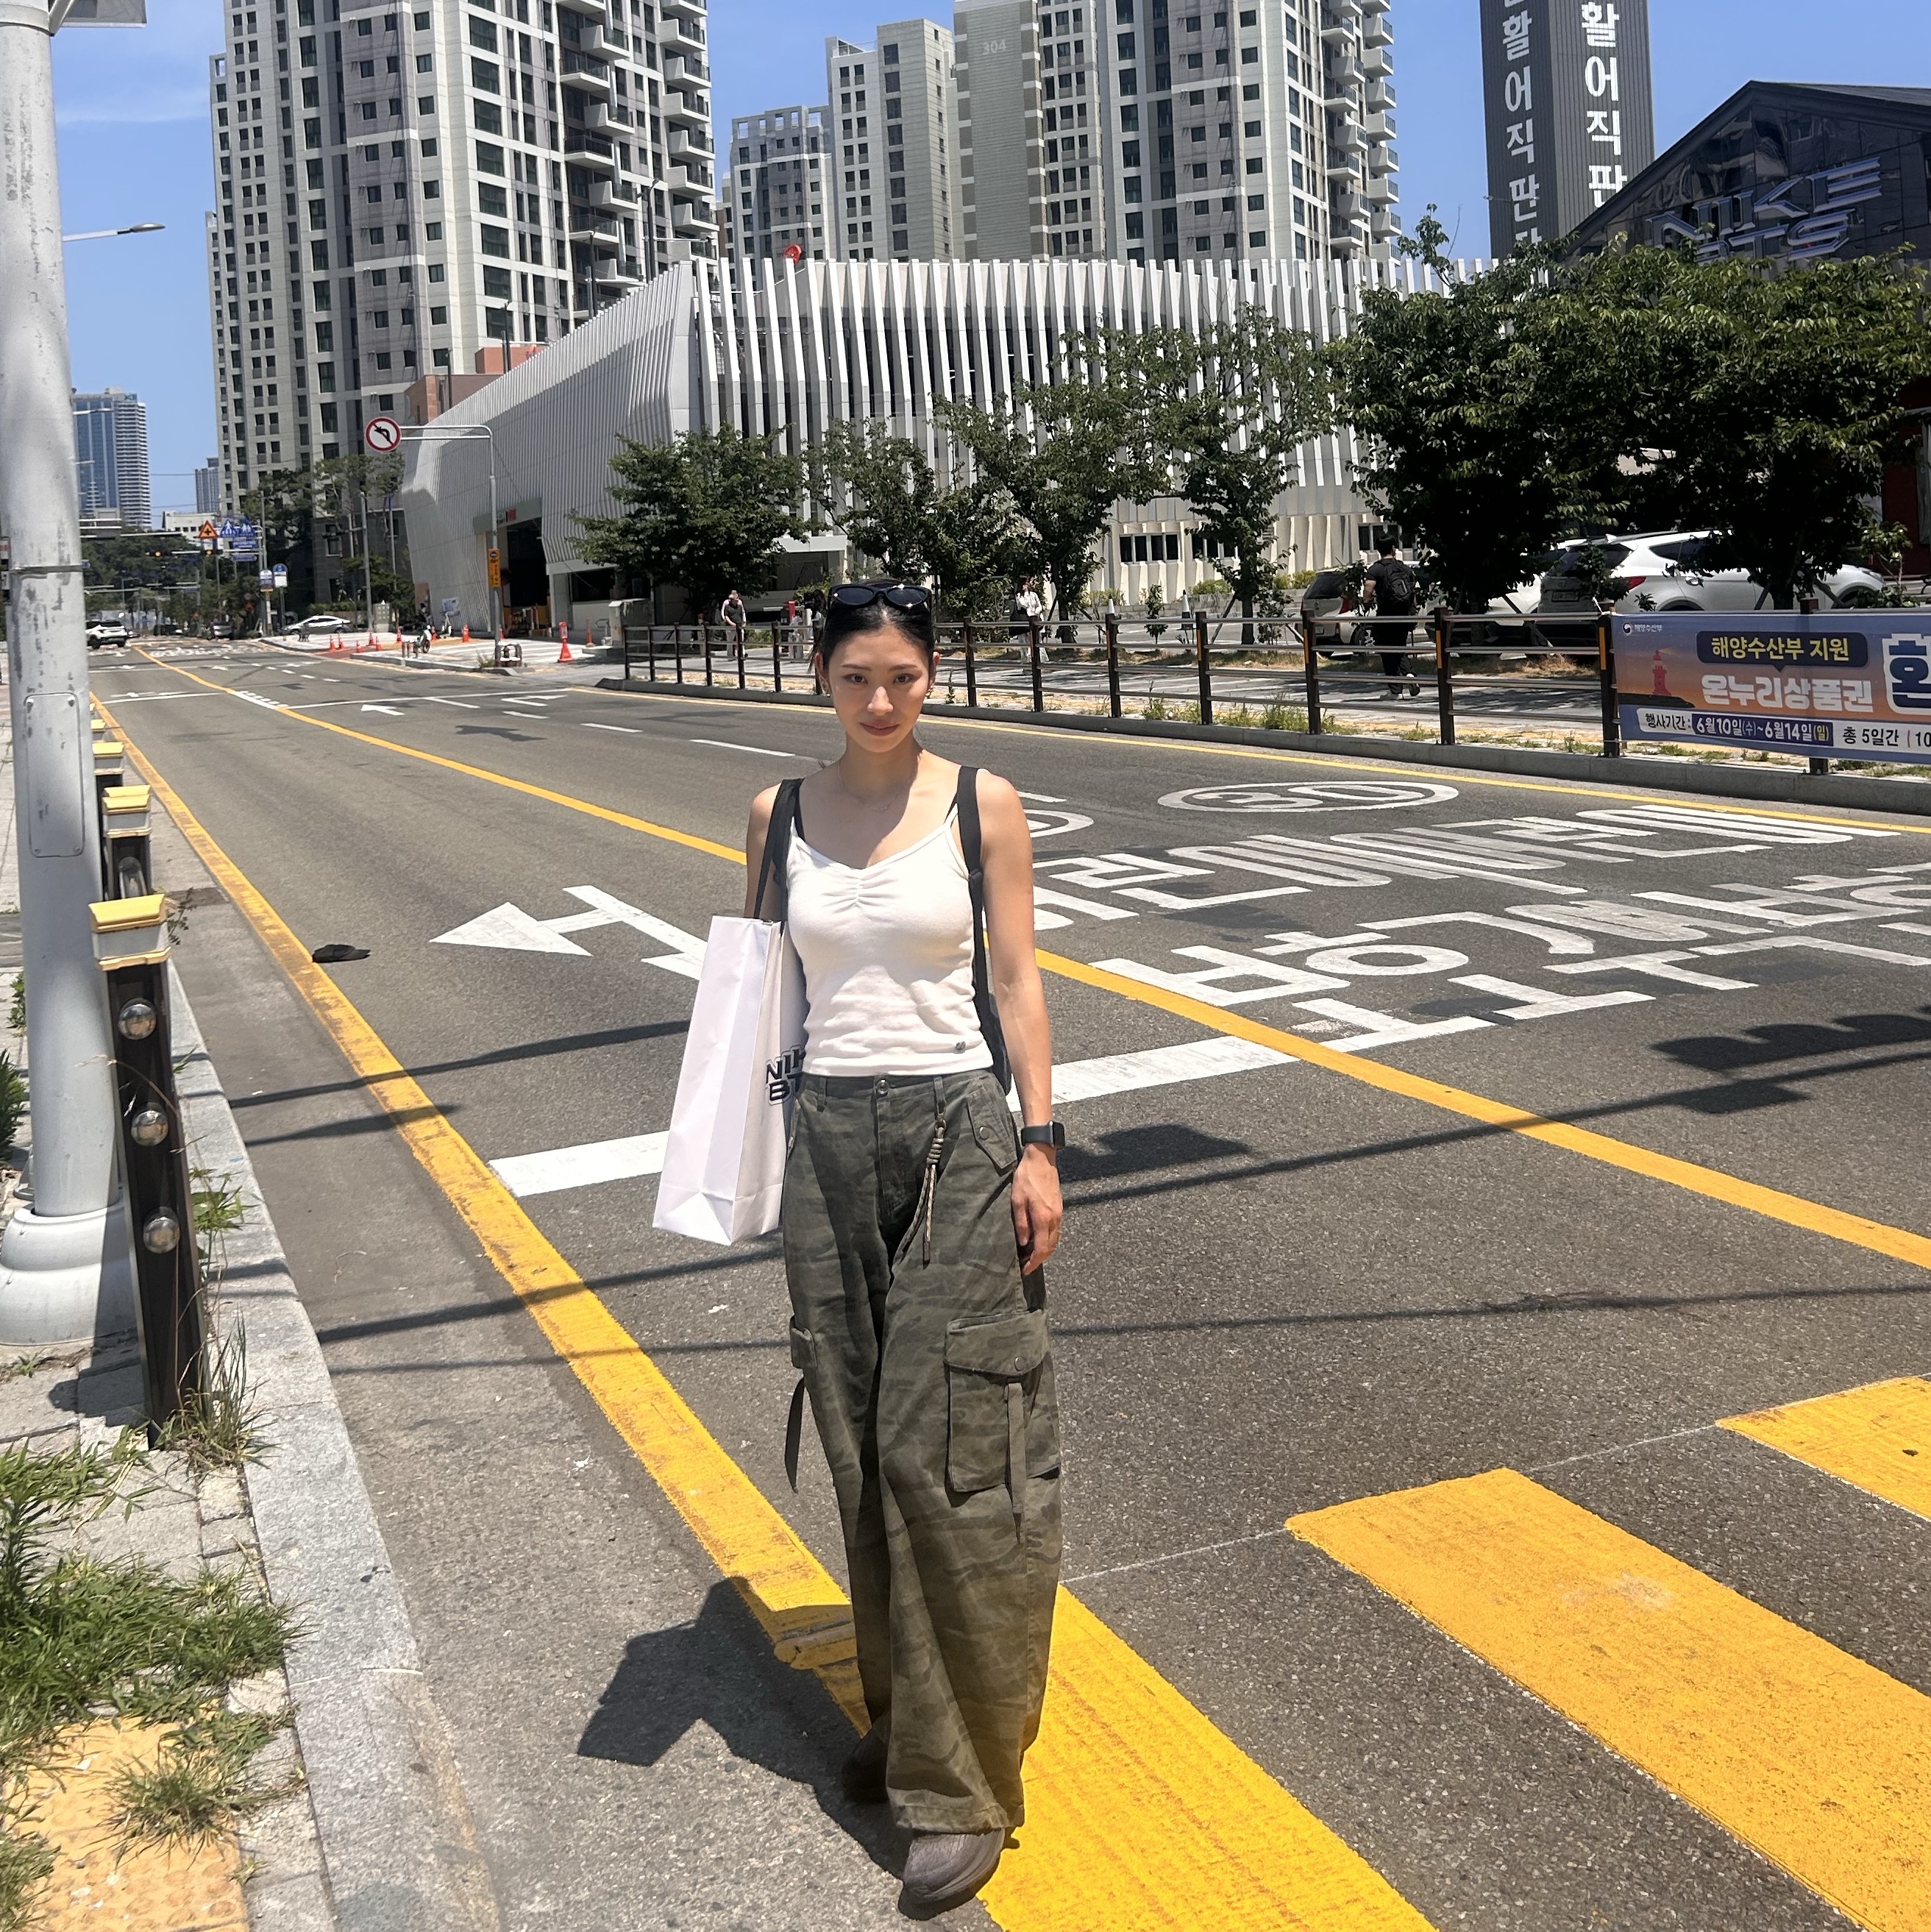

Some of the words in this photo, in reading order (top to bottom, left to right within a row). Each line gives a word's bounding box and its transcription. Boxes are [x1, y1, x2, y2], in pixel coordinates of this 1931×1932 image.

[1646, 157, 1882, 249] NIKE
[1711, 636, 1804, 660] 해양수산부
[1809, 637, 1850, 661] 지원
[1701, 675, 1874, 713] 온누리상품권
[1843, 726, 1857, 745] 총
[1862, 728, 1899, 747] 5일간
[1190, 784, 1426, 809] 30
[1330, 805, 1902, 870] 어린이
[1087, 900, 1931, 1053] 보호구역
[766, 1048, 806, 1084] NIK
[769, 1072, 803, 1101] BT
